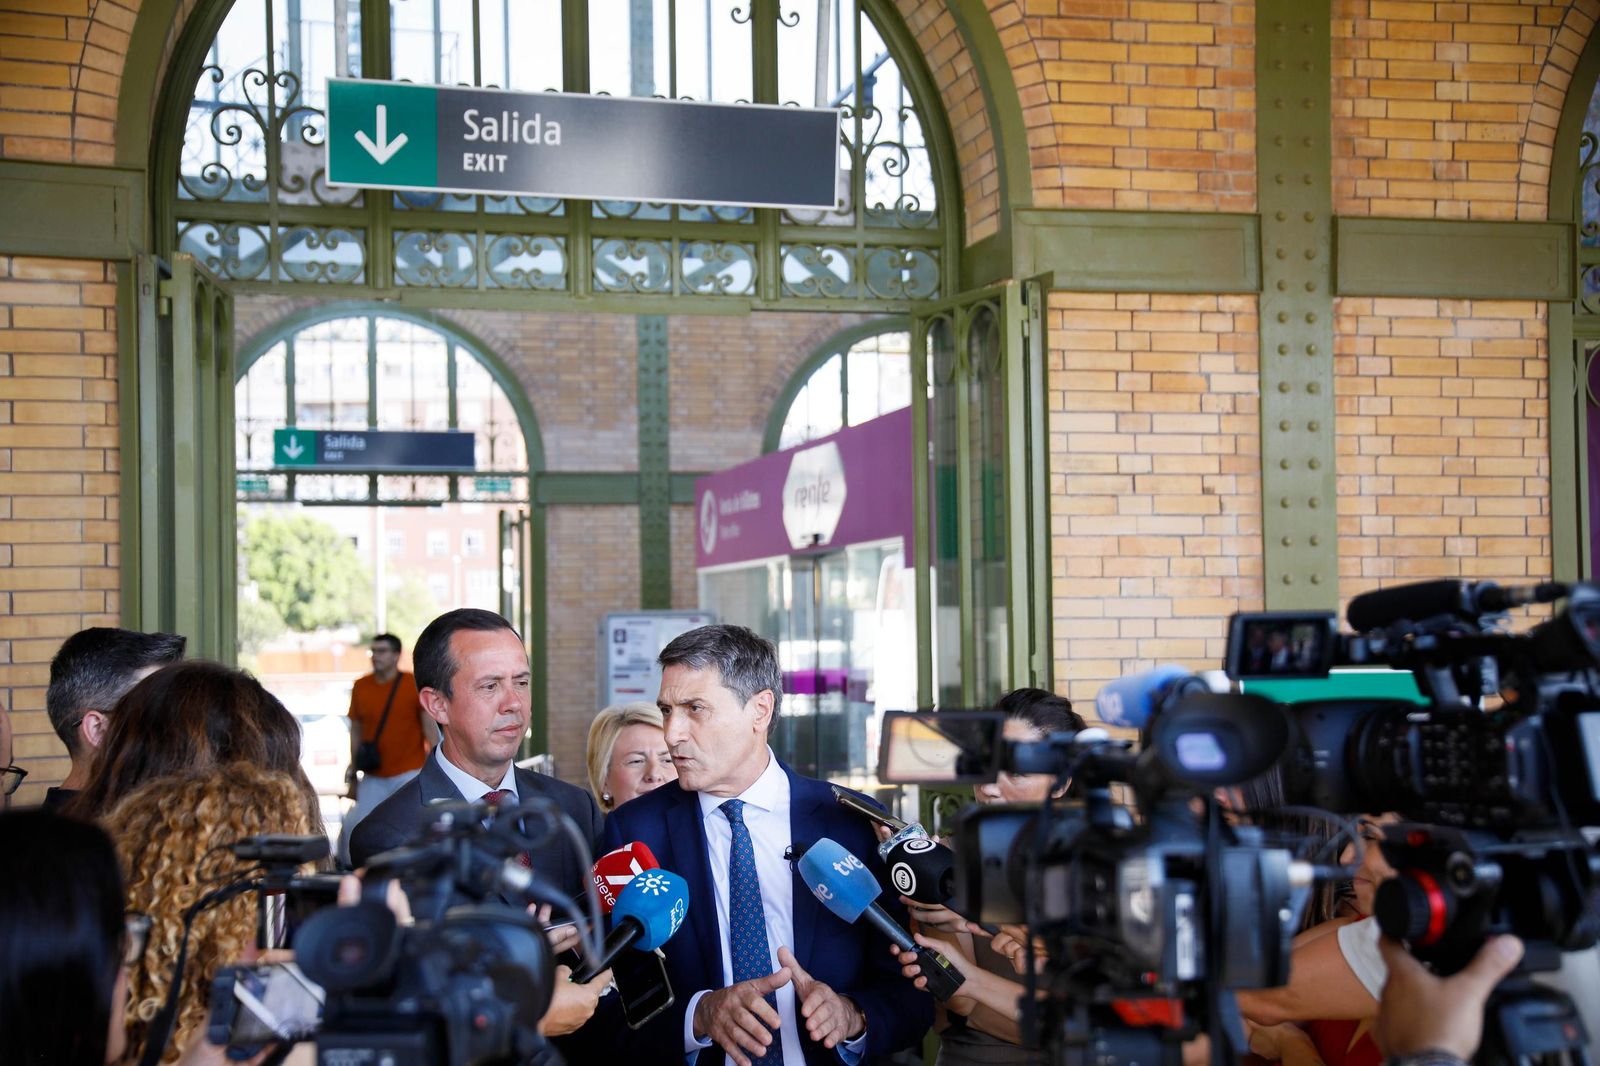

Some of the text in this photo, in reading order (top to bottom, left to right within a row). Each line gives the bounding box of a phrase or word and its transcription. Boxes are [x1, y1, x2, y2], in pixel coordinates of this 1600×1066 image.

[463, 108, 562, 146] Salida
[463, 152, 508, 173] EXIT
[323, 433, 366, 450] Salida
[794, 469, 831, 518] renfe
[832, 854, 864, 876] tve
